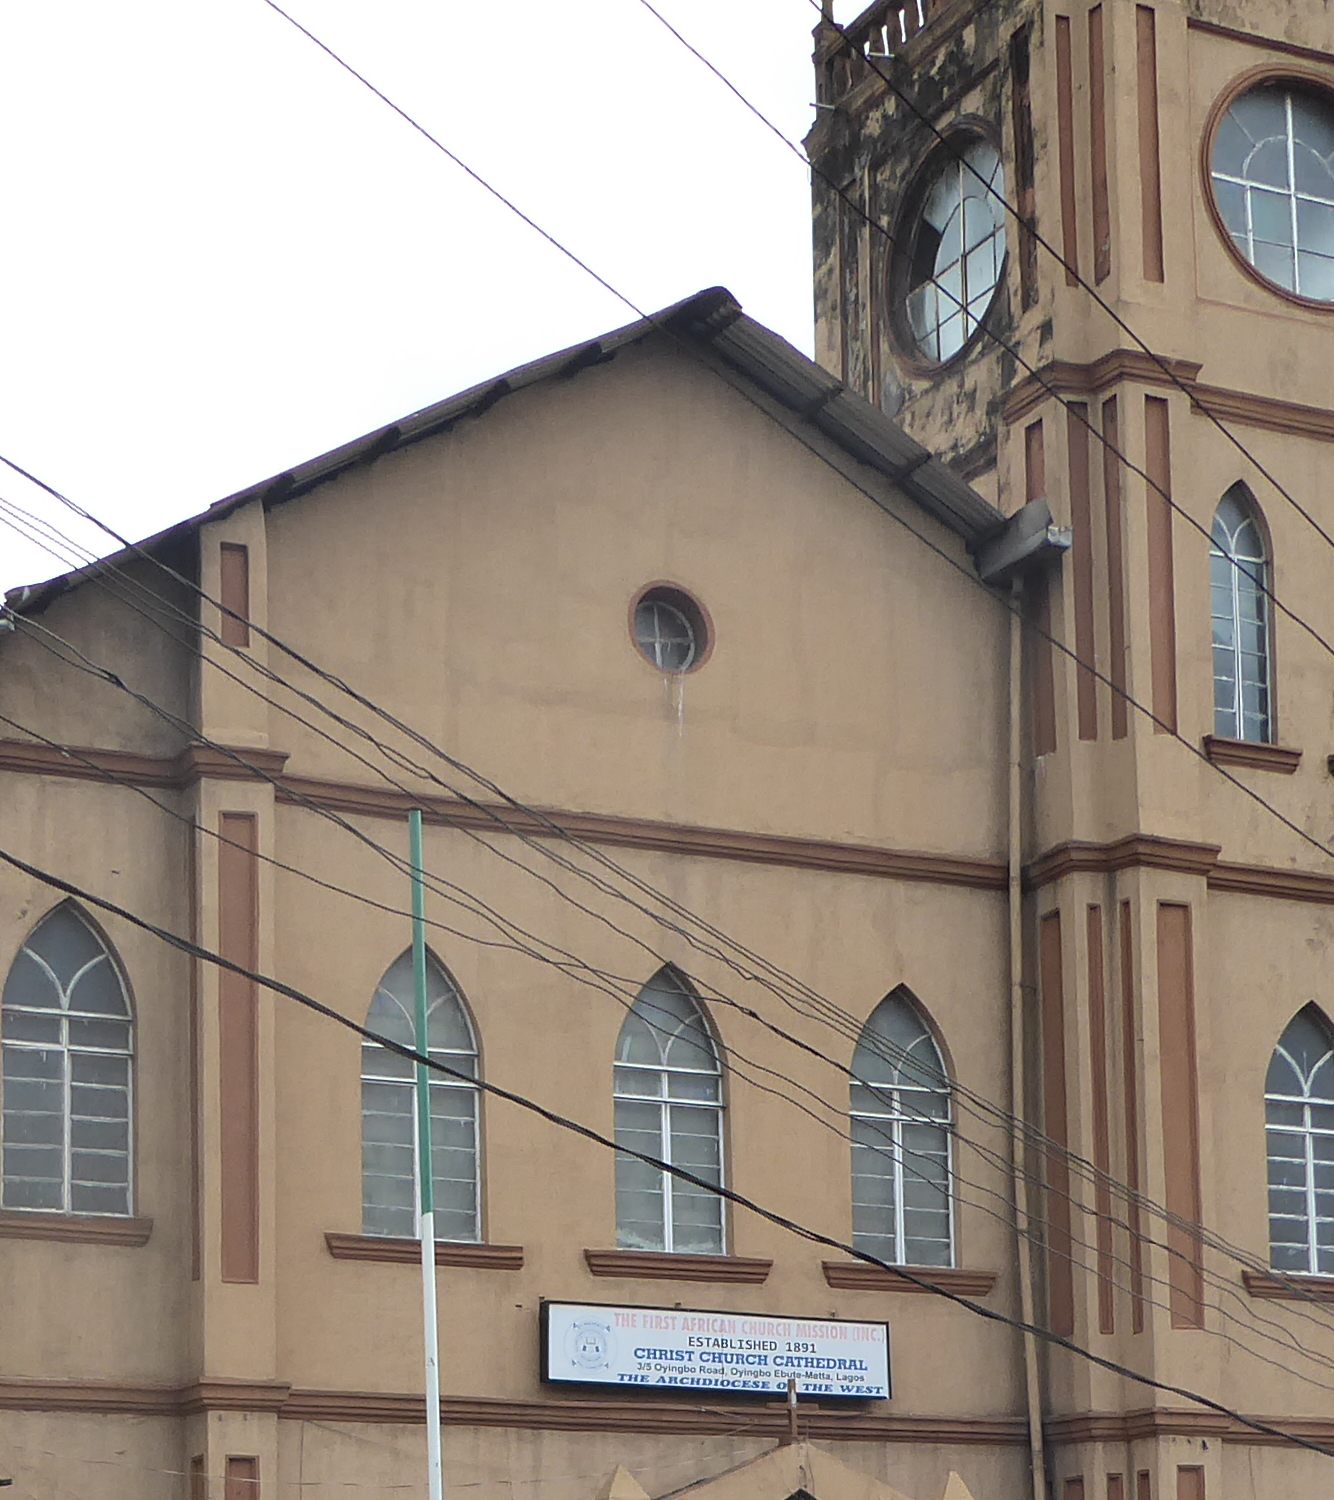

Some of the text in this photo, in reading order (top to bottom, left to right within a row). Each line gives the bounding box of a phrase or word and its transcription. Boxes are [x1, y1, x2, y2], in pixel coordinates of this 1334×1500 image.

[614, 1313, 637, 1328] THE
[642, 1314, 678, 1331] FIRST
[681, 1316, 737, 1334] AFRICAN
[741, 1320, 791, 1337] CHURCH
[795, 1323, 848, 1340] MISSION
[852, 1326, 885, 1343] (INC.)
[688, 1336, 817, 1353] ESTABLISHED 1891
[633, 1347, 868, 1371] CHRIST CHURCH CATHEDRAL
[654, 1362, 696, 1375] Oyingbo
[730, 1367, 772, 1379] Oyingbo
[836, 1373, 865, 1383] Lagos
[617, 1373, 650, 1382] THE
[655, 1375, 770, 1390] ARCHDIOCESE
[802, 1383, 833, 1392] THE
[839, 1384, 884, 1394] WEST
